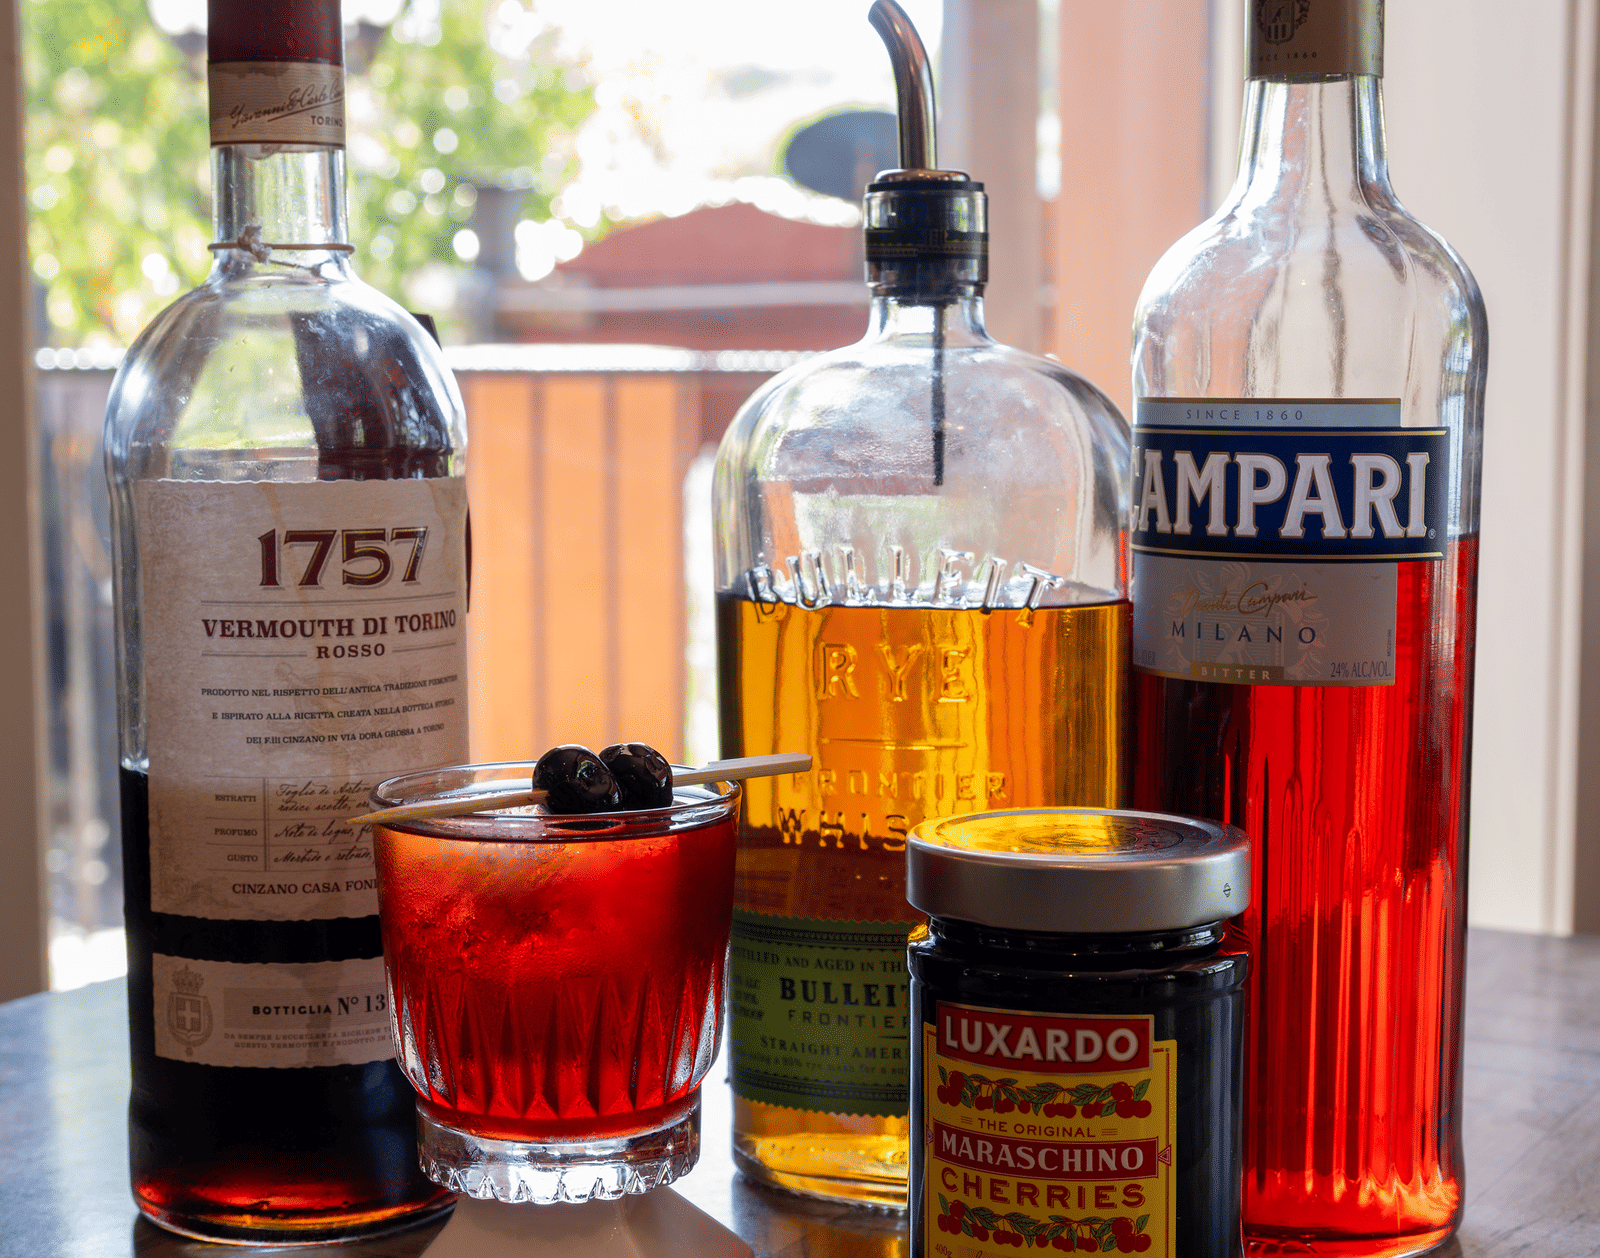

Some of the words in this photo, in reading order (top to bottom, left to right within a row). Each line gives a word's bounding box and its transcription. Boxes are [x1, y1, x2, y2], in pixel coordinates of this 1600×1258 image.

[1287, 51, 1317, 59] 1860
[287, 87, 301, 110] &
[1187, 409, 1240, 420] SINCE
[1255, 410, 1304, 421] 1860
[257, 526, 429, 588] 1757
[745, 545, 1065, 628] BULLEIT
[1237, 581, 1318, 618] Campari
[201, 618, 354, 638] VERMOUTH
[363, 617, 388, 635] DI
[394, 609, 457, 632] TORINO
[1172, 621, 1316, 644] MILANO
[316, 644, 386, 659] ROSSO
[817, 642, 970, 702] RYE
[1201, 667, 1270, 680] BITTER
[1330, 662, 1349, 678] 24%
[201, 688, 249, 696] PRODOTTO
[273, 688, 320, 696] RISPETTO
[383, 680, 427, 691] TRADIZIONE
[221, 712, 263, 720] ISPIRATO
[294, 711, 334, 719] RICETTA
[337, 709, 371, 718] CREATA
[374, 707, 400, 716] NELLA
[402, 703, 433, 713] BOTTEGA
[246, 736, 262, 744] DEI
[282, 735, 325, 743] CINZANO
[341, 733, 356, 741] VIA
[359, 731, 382, 740] DORA
[385, 728, 415, 738] GROSSA
[423, 723, 445, 733] TORINO
[215, 794, 257, 802] ESTRATTI
[214, 828, 258, 836] PROFUMO
[232, 883, 298, 894] CINZANO
[302, 882, 341, 894] CASA
[784, 956, 809, 968] AND
[814, 958, 855, 972] AGED
[861, 960, 874, 972] IN
[880, 960, 907, 973] TH
[252, 1005, 332, 1016] BOTTIGLIA
[365, 994, 386, 1013] 13
[270, 1041, 319, 1049] VERMOUTH
[331, 1038, 375, 1047] PRODOTTO
[760, 1036, 841, 1056] STRAIGHT
[945, 1015, 1139, 1063] LUXARDO
[978, 1117, 1007, 1132] THE
[1014, 1123, 1096, 1138] ORIGINAL
[941, 1130, 1144, 1172] MARASCHINO
[941, 1167, 1146, 1209] CHERRIES
